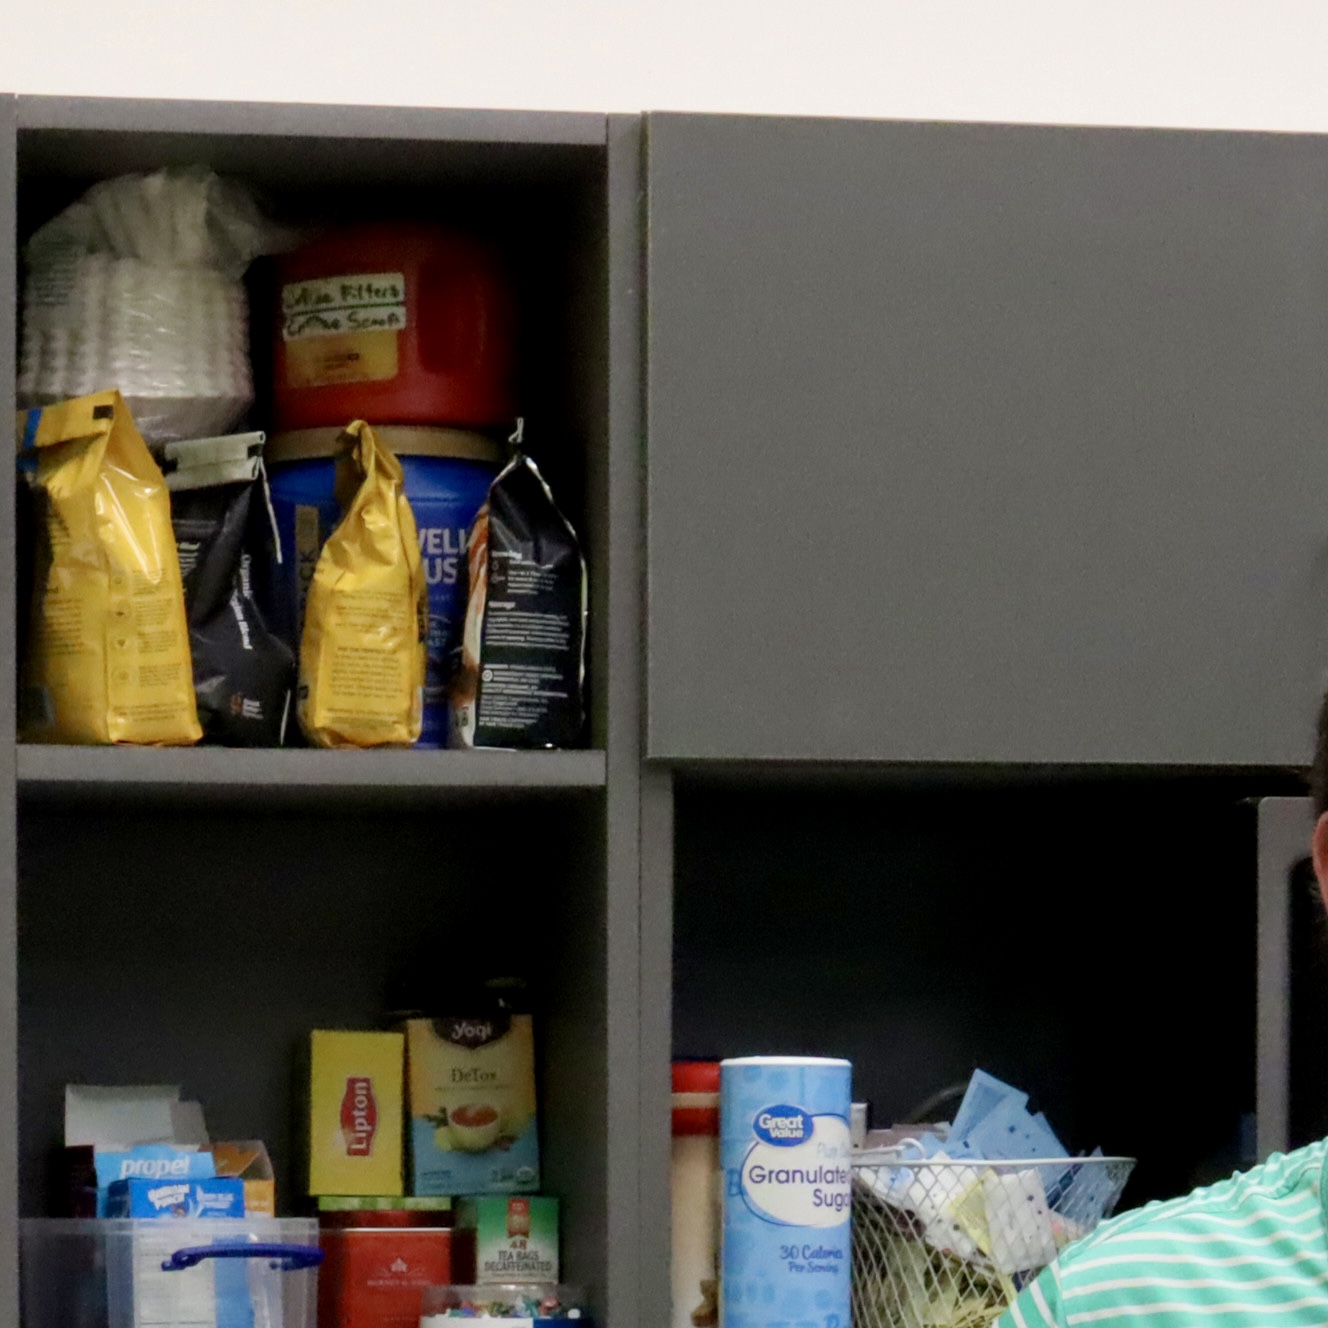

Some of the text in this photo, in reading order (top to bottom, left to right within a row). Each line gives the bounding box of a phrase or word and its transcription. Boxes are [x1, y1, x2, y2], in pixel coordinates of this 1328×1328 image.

[349, 1081, 372, 1150] Lipton
[758, 1113, 804, 1130] Great
[768, 1126, 805, 1139] Value
[120, 1155, 191, 1180] propel
[498, 1250, 540, 1261] TEA BAGS
[780, 1244, 800, 1260] 30
[484, 1260, 552, 1272] DECAFFEINATED
